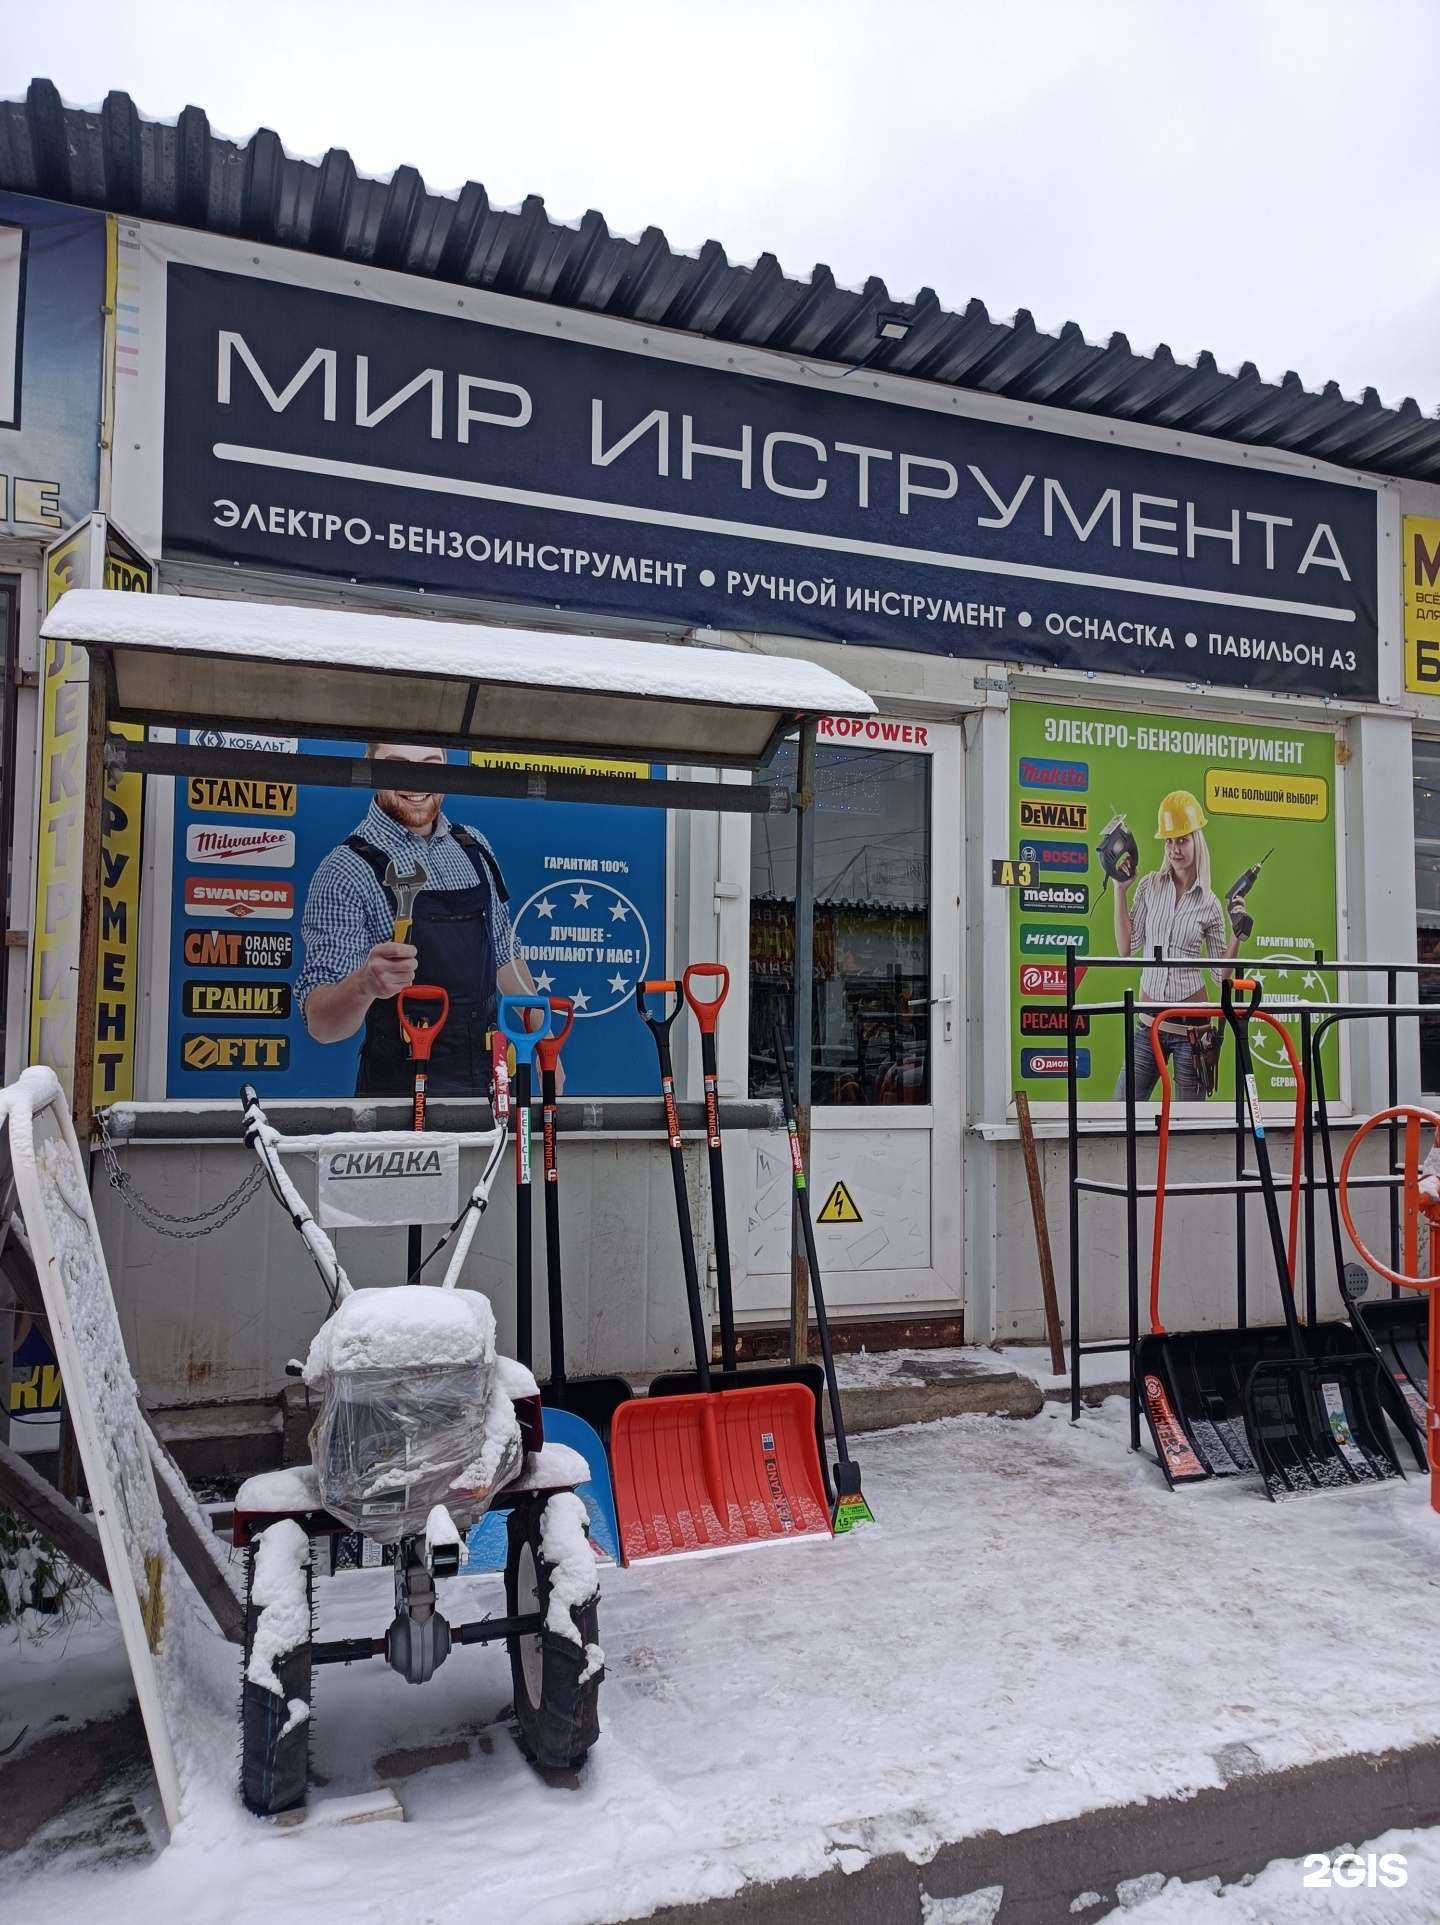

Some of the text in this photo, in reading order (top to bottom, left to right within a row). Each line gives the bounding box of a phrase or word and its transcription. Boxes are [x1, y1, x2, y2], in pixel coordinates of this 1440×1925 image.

[217, 329, 1352, 582] МИР ИНСТРУМЕНТА
[213, 498, 687, 589] ЭЛЕКТРО-БЕНЗОИНСТРУМЕНТ
[727, 570, 837, 608] РУЧНОЙ
[846, 586, 1007, 629] ИНСТРУМЕНТ
[1045, 612, 1175, 649] ОСНАСТКА
[1208, 633, 1325, 667] ПАВИЛЬОН
[816, 715, 928, 747] ROPOWER
[229, 738, 285, 751] КОБАЛЬТ
[1044, 718, 1304, 764] ЭЛЕКТРО-БЕНЗОИНСТРУМЕНТ
[191, 778, 293, 811] STANLEY
[1214, 786, 1319, 805] У НАС БОЛЬШОЙ ВЫБОР!
[192, 831, 288, 852] Milwaukee
[544, 856, 629, 873] ГАРАНТИЯ 100%
[1042, 850, 1088, 865] BOSCH
[192, 886, 288, 902] SWANSON
[1024, 888, 1084, 903] metabo
[245, 935, 292, 952] ORANGE
[550, 926, 604, 943] ЛУЧШЕЕ
[184, 932, 243, 965] CMT
[520, 945, 594, 962] ПОКУПАЮТ
[244, 950, 282, 967] TOOLS
[192, 986, 283, 1010] ГРАНИТ
[1022, 1012, 1086, 1030] РЕСАНА
[216, 1037, 287, 1067] FIT
[329, 1150, 441, 1177] СКИДКА
